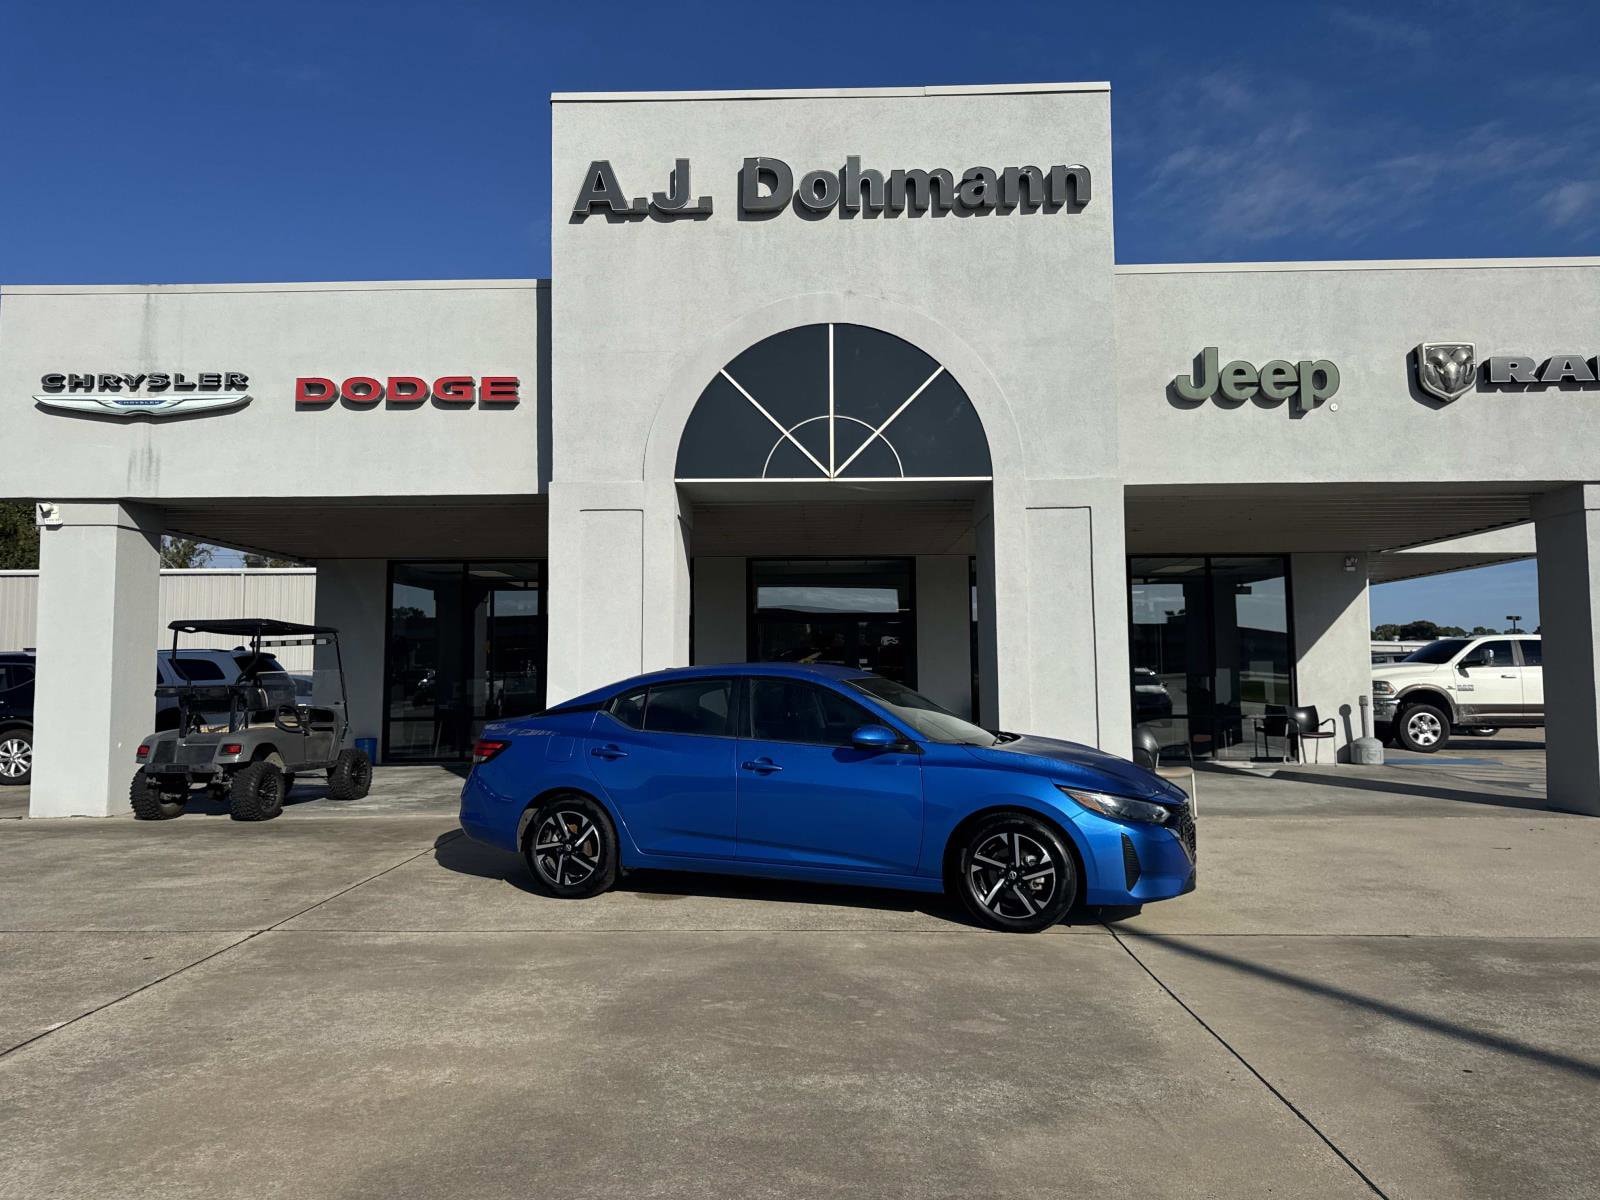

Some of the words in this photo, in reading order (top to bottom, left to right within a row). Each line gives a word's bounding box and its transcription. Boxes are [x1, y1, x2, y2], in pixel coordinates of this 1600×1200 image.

[571, 158, 713, 217] A.J.
[740, 155, 1092, 216] Dohmann
[41, 371, 250, 392] CHRYSLER
[1174, 346, 1341, 411] Jeep
[1489, 354, 1600, 384] RA
[295, 375, 520, 407] DODGE
